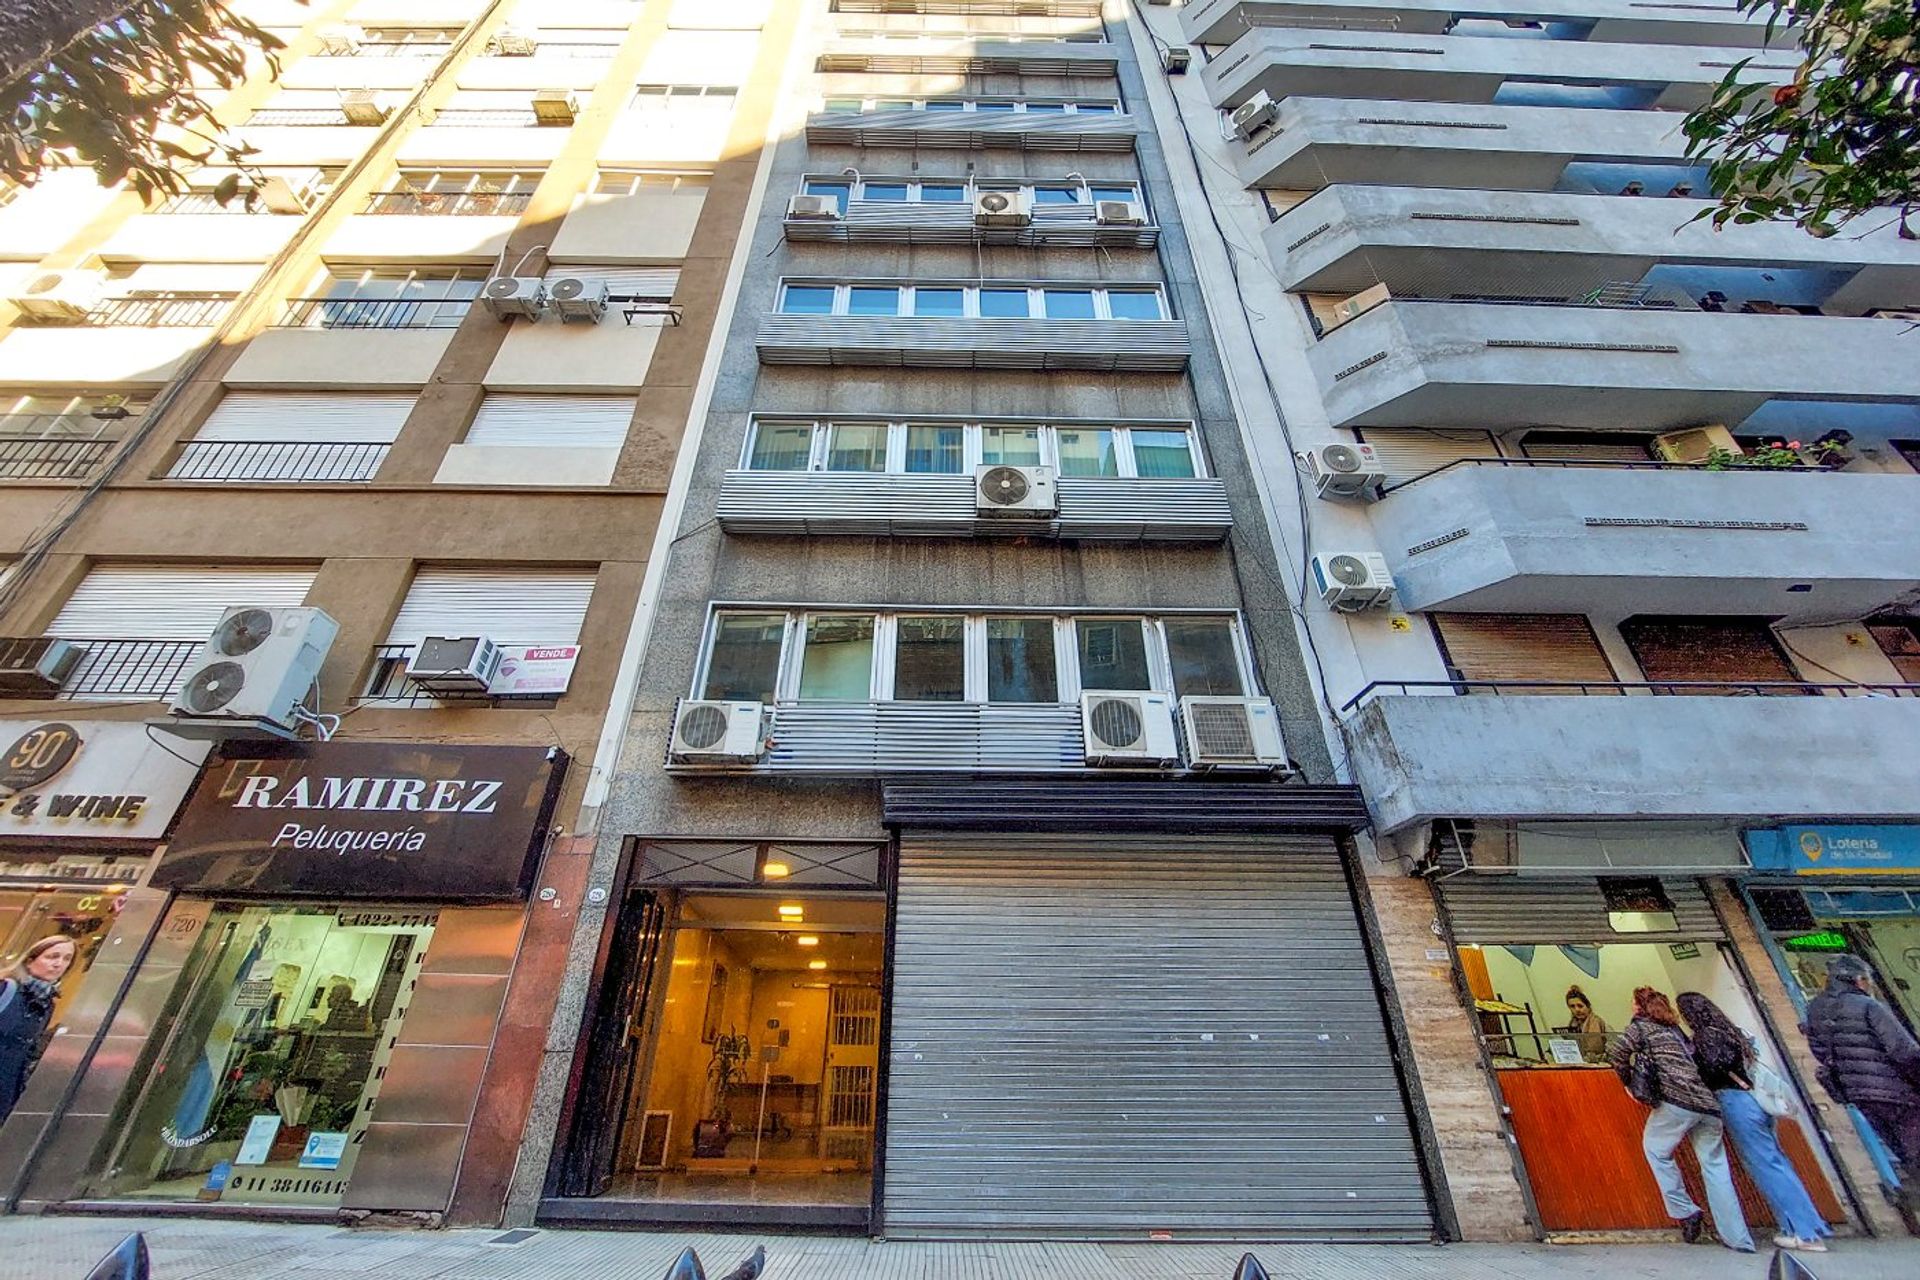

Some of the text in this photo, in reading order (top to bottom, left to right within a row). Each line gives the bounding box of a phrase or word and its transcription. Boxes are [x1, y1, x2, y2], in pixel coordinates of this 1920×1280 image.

[533, 649, 568, 659] VENDE
[47, 794, 147, 821] WINE
[232, 776, 504, 814] RAMIREZ
[271, 823, 427, 855] Peluquería
